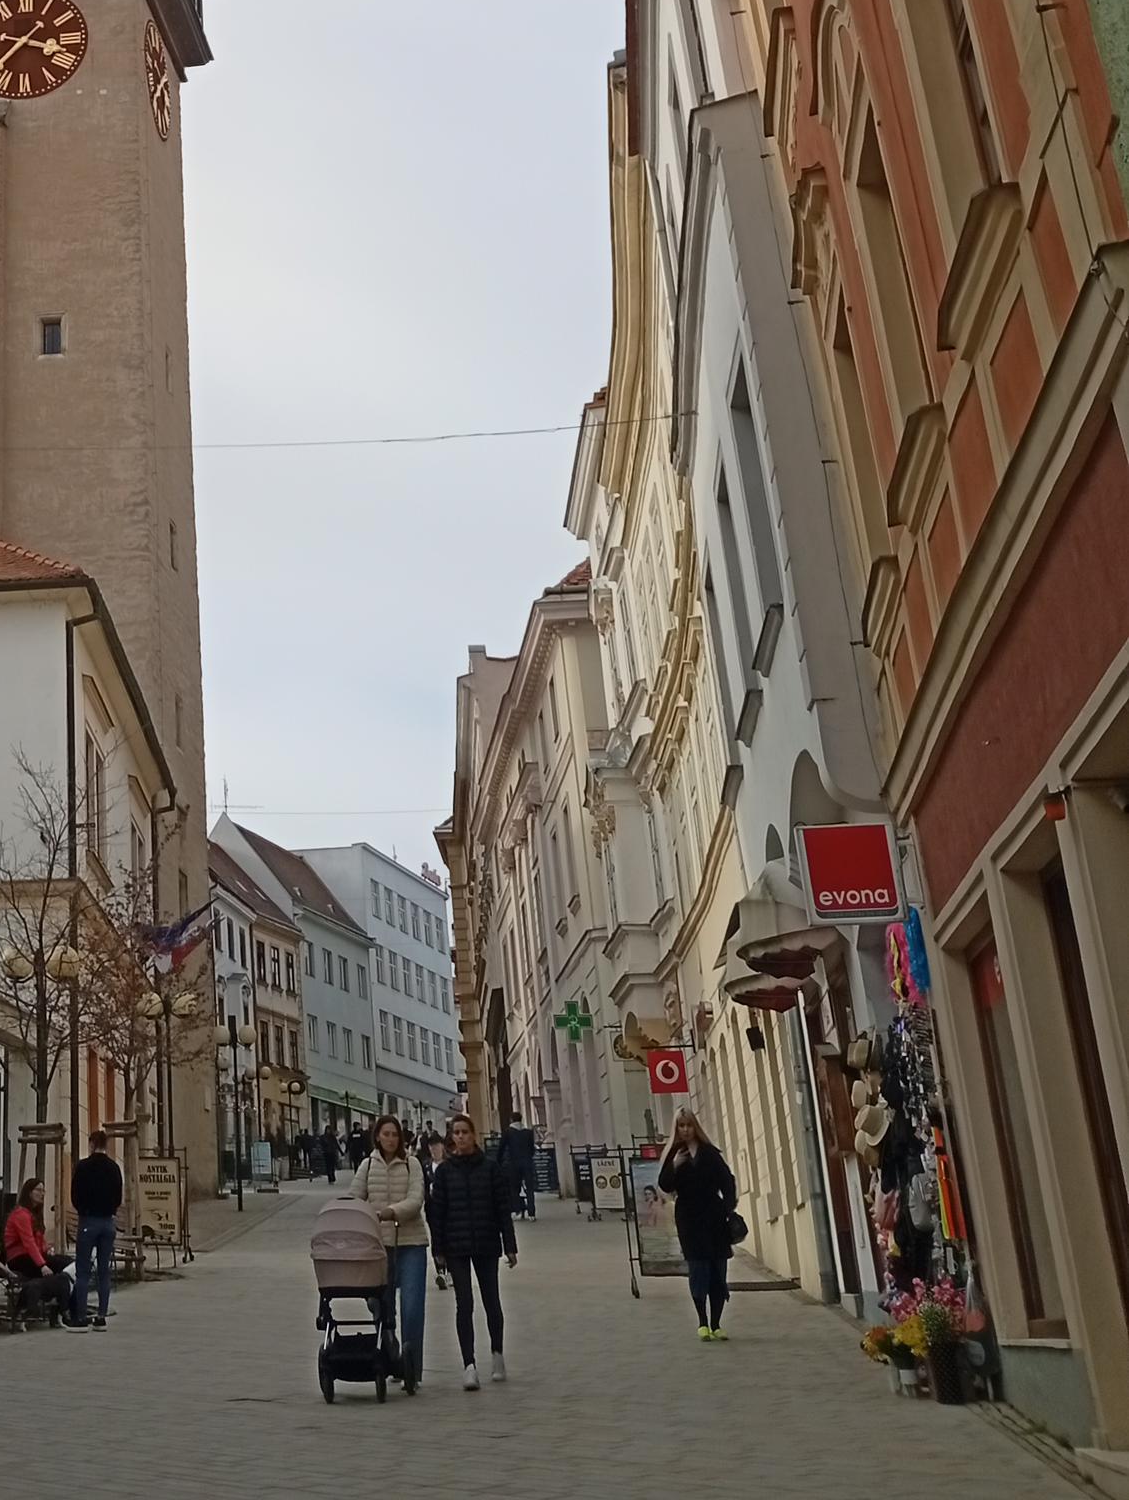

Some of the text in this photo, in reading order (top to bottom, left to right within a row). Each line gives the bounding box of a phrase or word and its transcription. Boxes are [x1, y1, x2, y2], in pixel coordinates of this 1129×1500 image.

[53, 10, 74, 27] II
[59, 32, 81, 45] III
[41, 66, 56, 84] V
[819, 888, 889, 906] evona
[146, 1165, 168, 1173] ANTIK
[139, 1174, 176, 1183] NOSTALGIA
